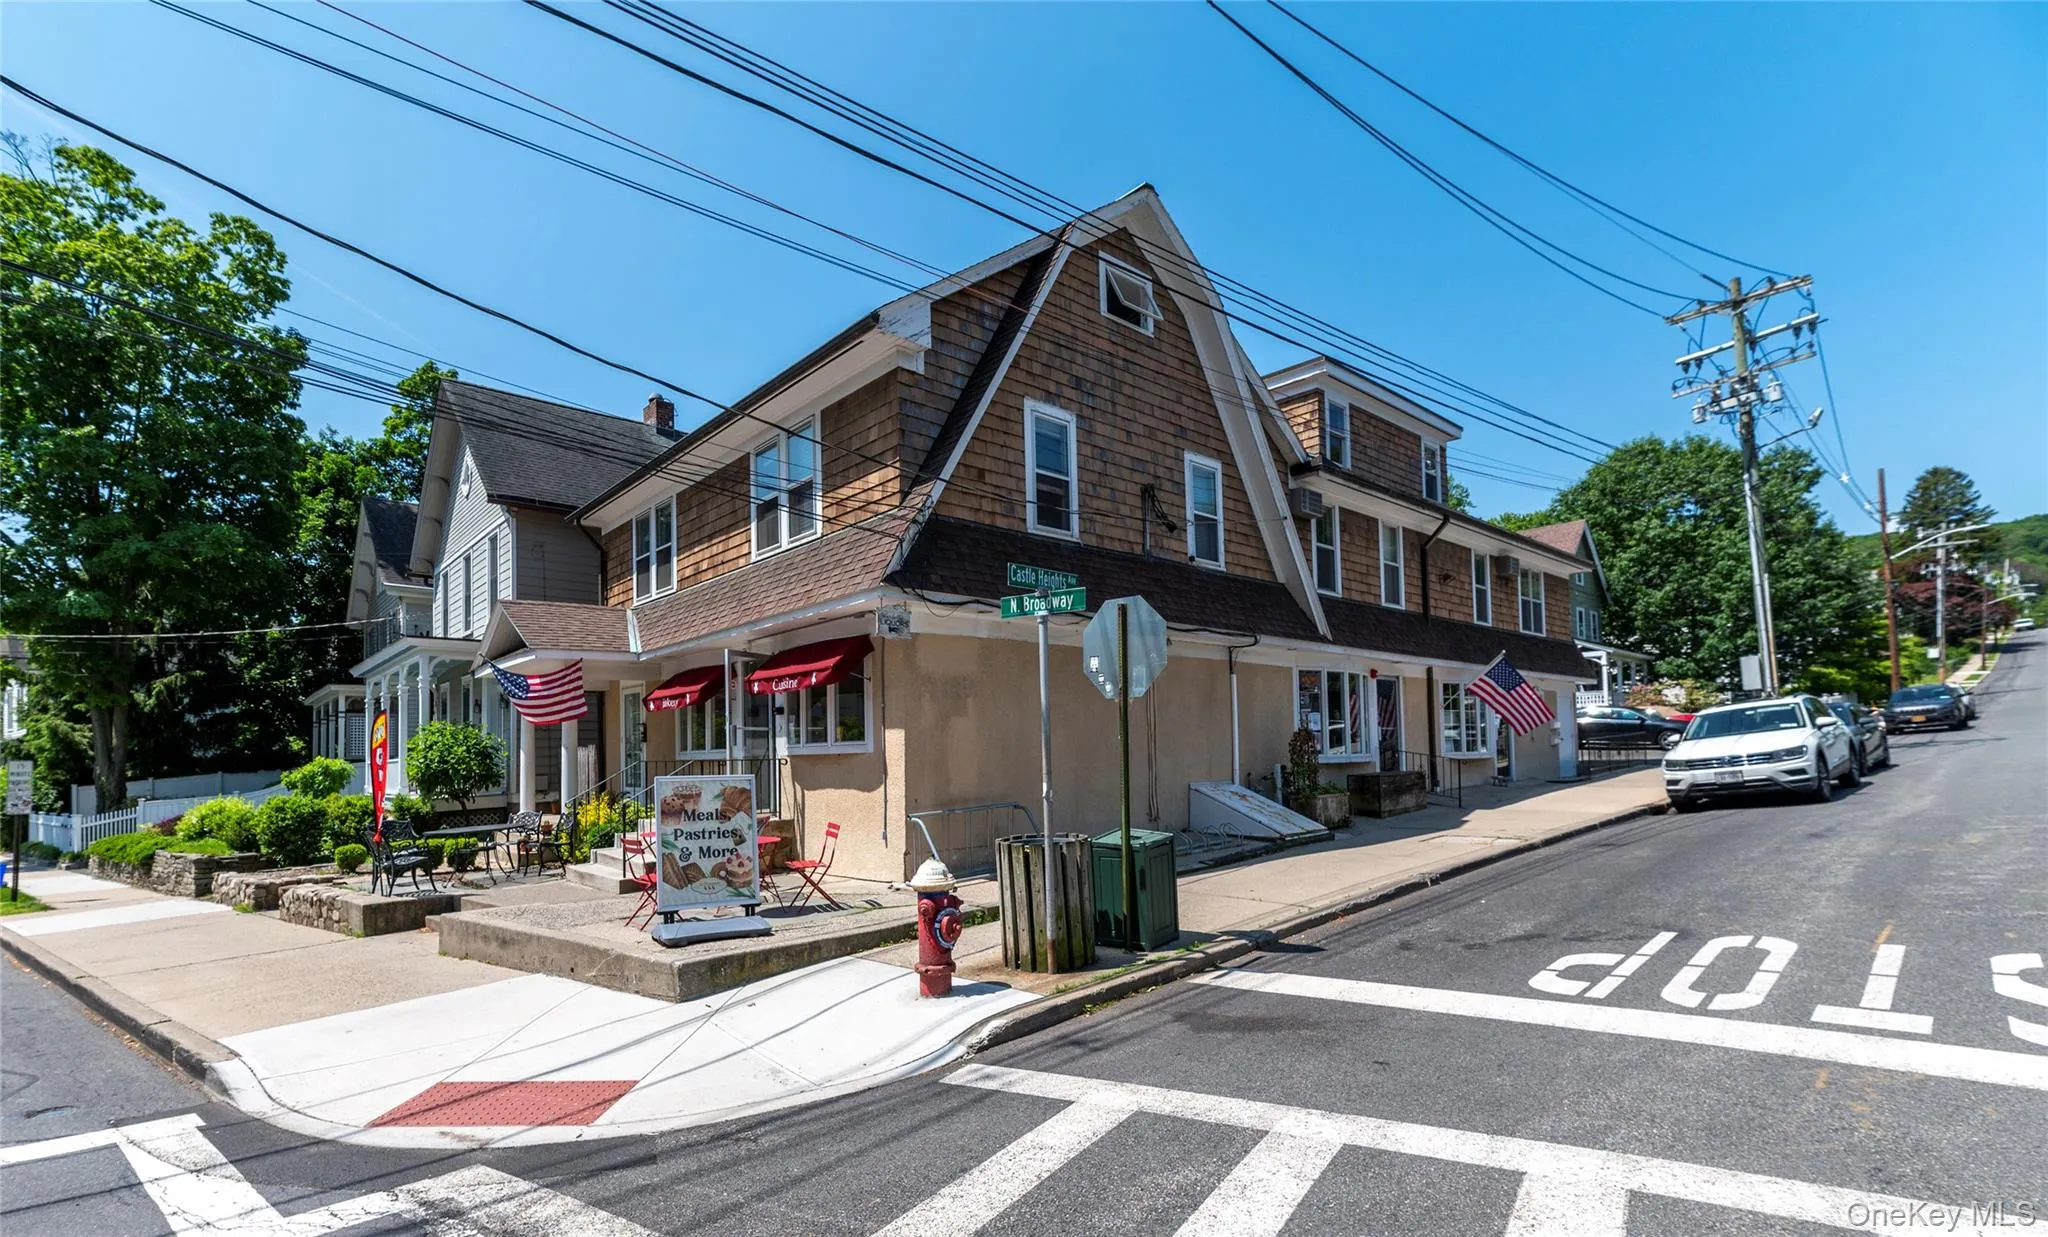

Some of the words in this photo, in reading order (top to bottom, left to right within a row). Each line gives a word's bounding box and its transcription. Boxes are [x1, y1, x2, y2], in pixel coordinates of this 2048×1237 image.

[1010, 564, 1036, 585] Castle
[1038, 569, 1067, 590] Heights
[1010, 598, 1020, 613] N.
[1023, 592, 1074, 612] Broadway
[772, 678, 799, 691] Cuisine
[683, 808, 731, 822] Meals,
[673, 827, 742, 841] Pastries,
[679, 847, 692, 862] &
[699, 846, 738, 859] More
